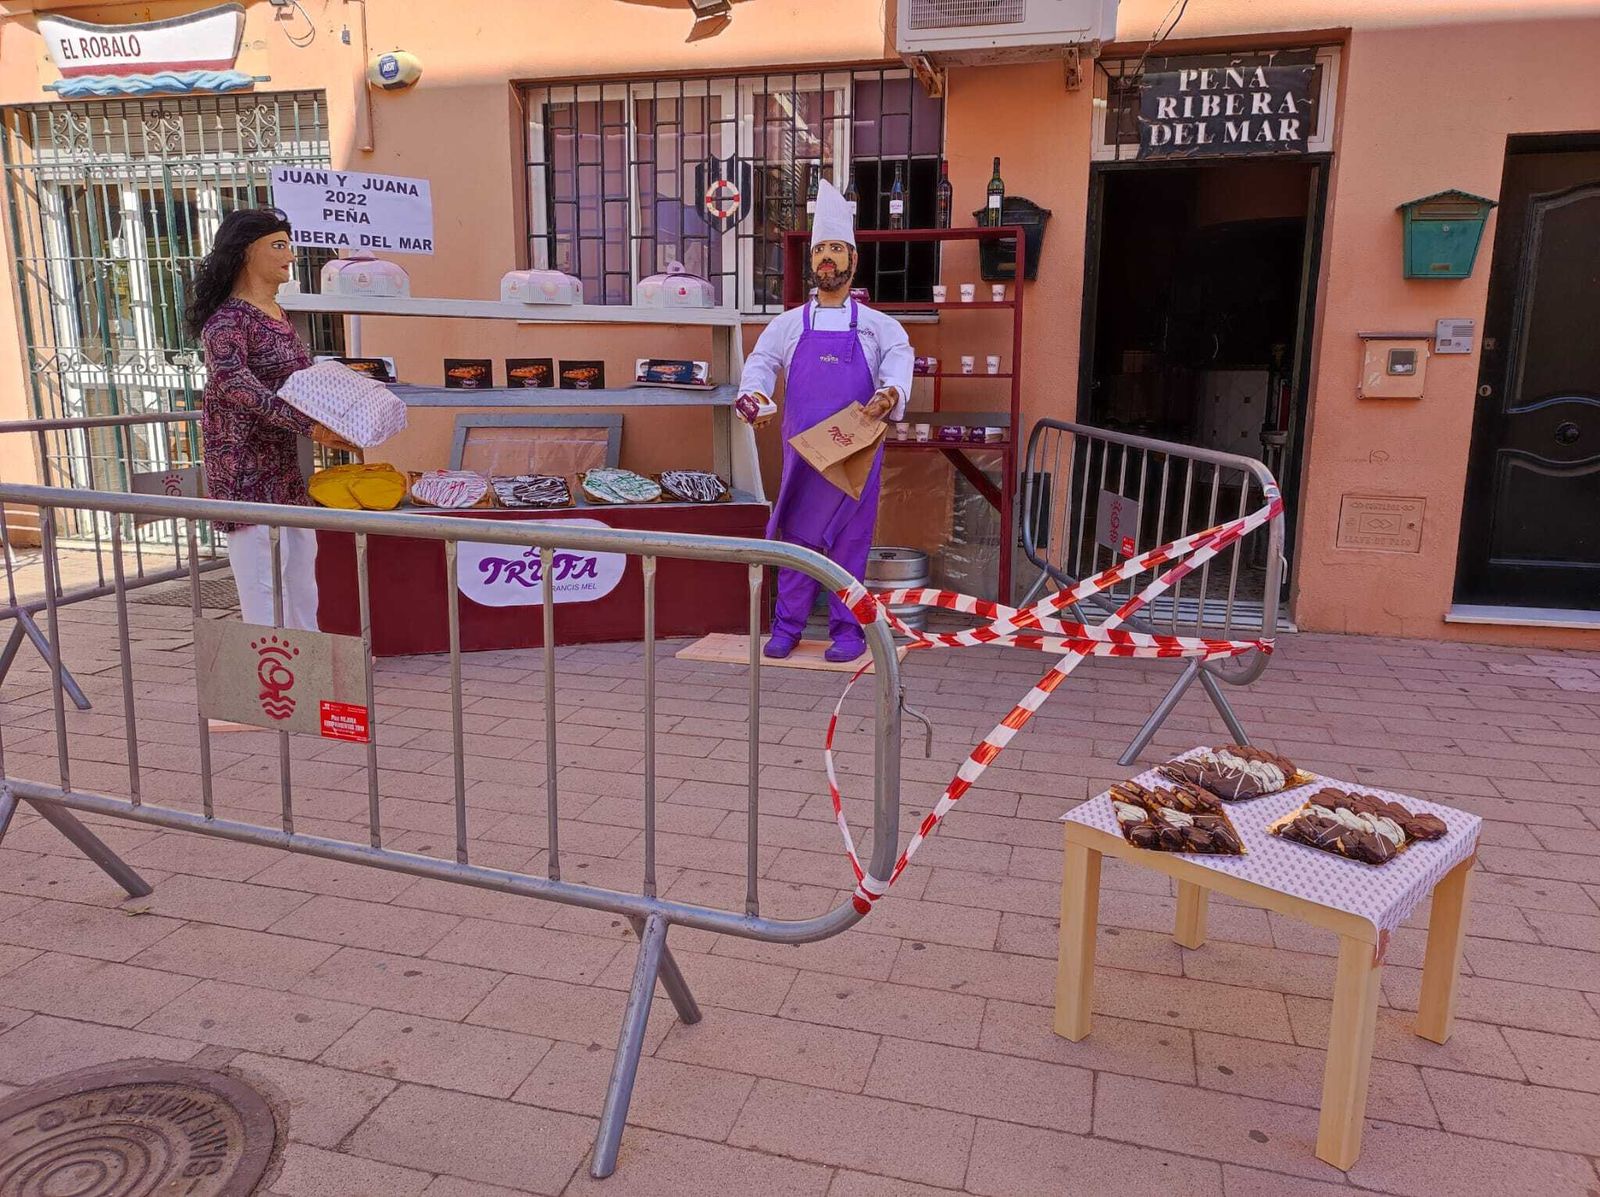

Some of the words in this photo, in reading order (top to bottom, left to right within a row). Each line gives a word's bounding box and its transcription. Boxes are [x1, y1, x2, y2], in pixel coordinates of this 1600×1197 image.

[60, 38, 79, 60] EL
[79, 34, 141, 58] ROBALO
[1178, 59, 1270, 91] PEÑA
[1156, 91, 1300, 119] RIBERA
[1149, 121, 1216, 146] DEL
[1223, 118, 1301, 143] MAR
[278, 170, 329, 185] JUAN
[336, 174, 348, 187] Y
[362, 178, 419, 197] JUANA
[325, 190, 367, 206] 2022
[323, 206, 371, 224] PEÑA
[360, 234, 392, 249] DEL
[399, 236, 433, 250] MAR
[552, 584, 580, 592] RANCIS
